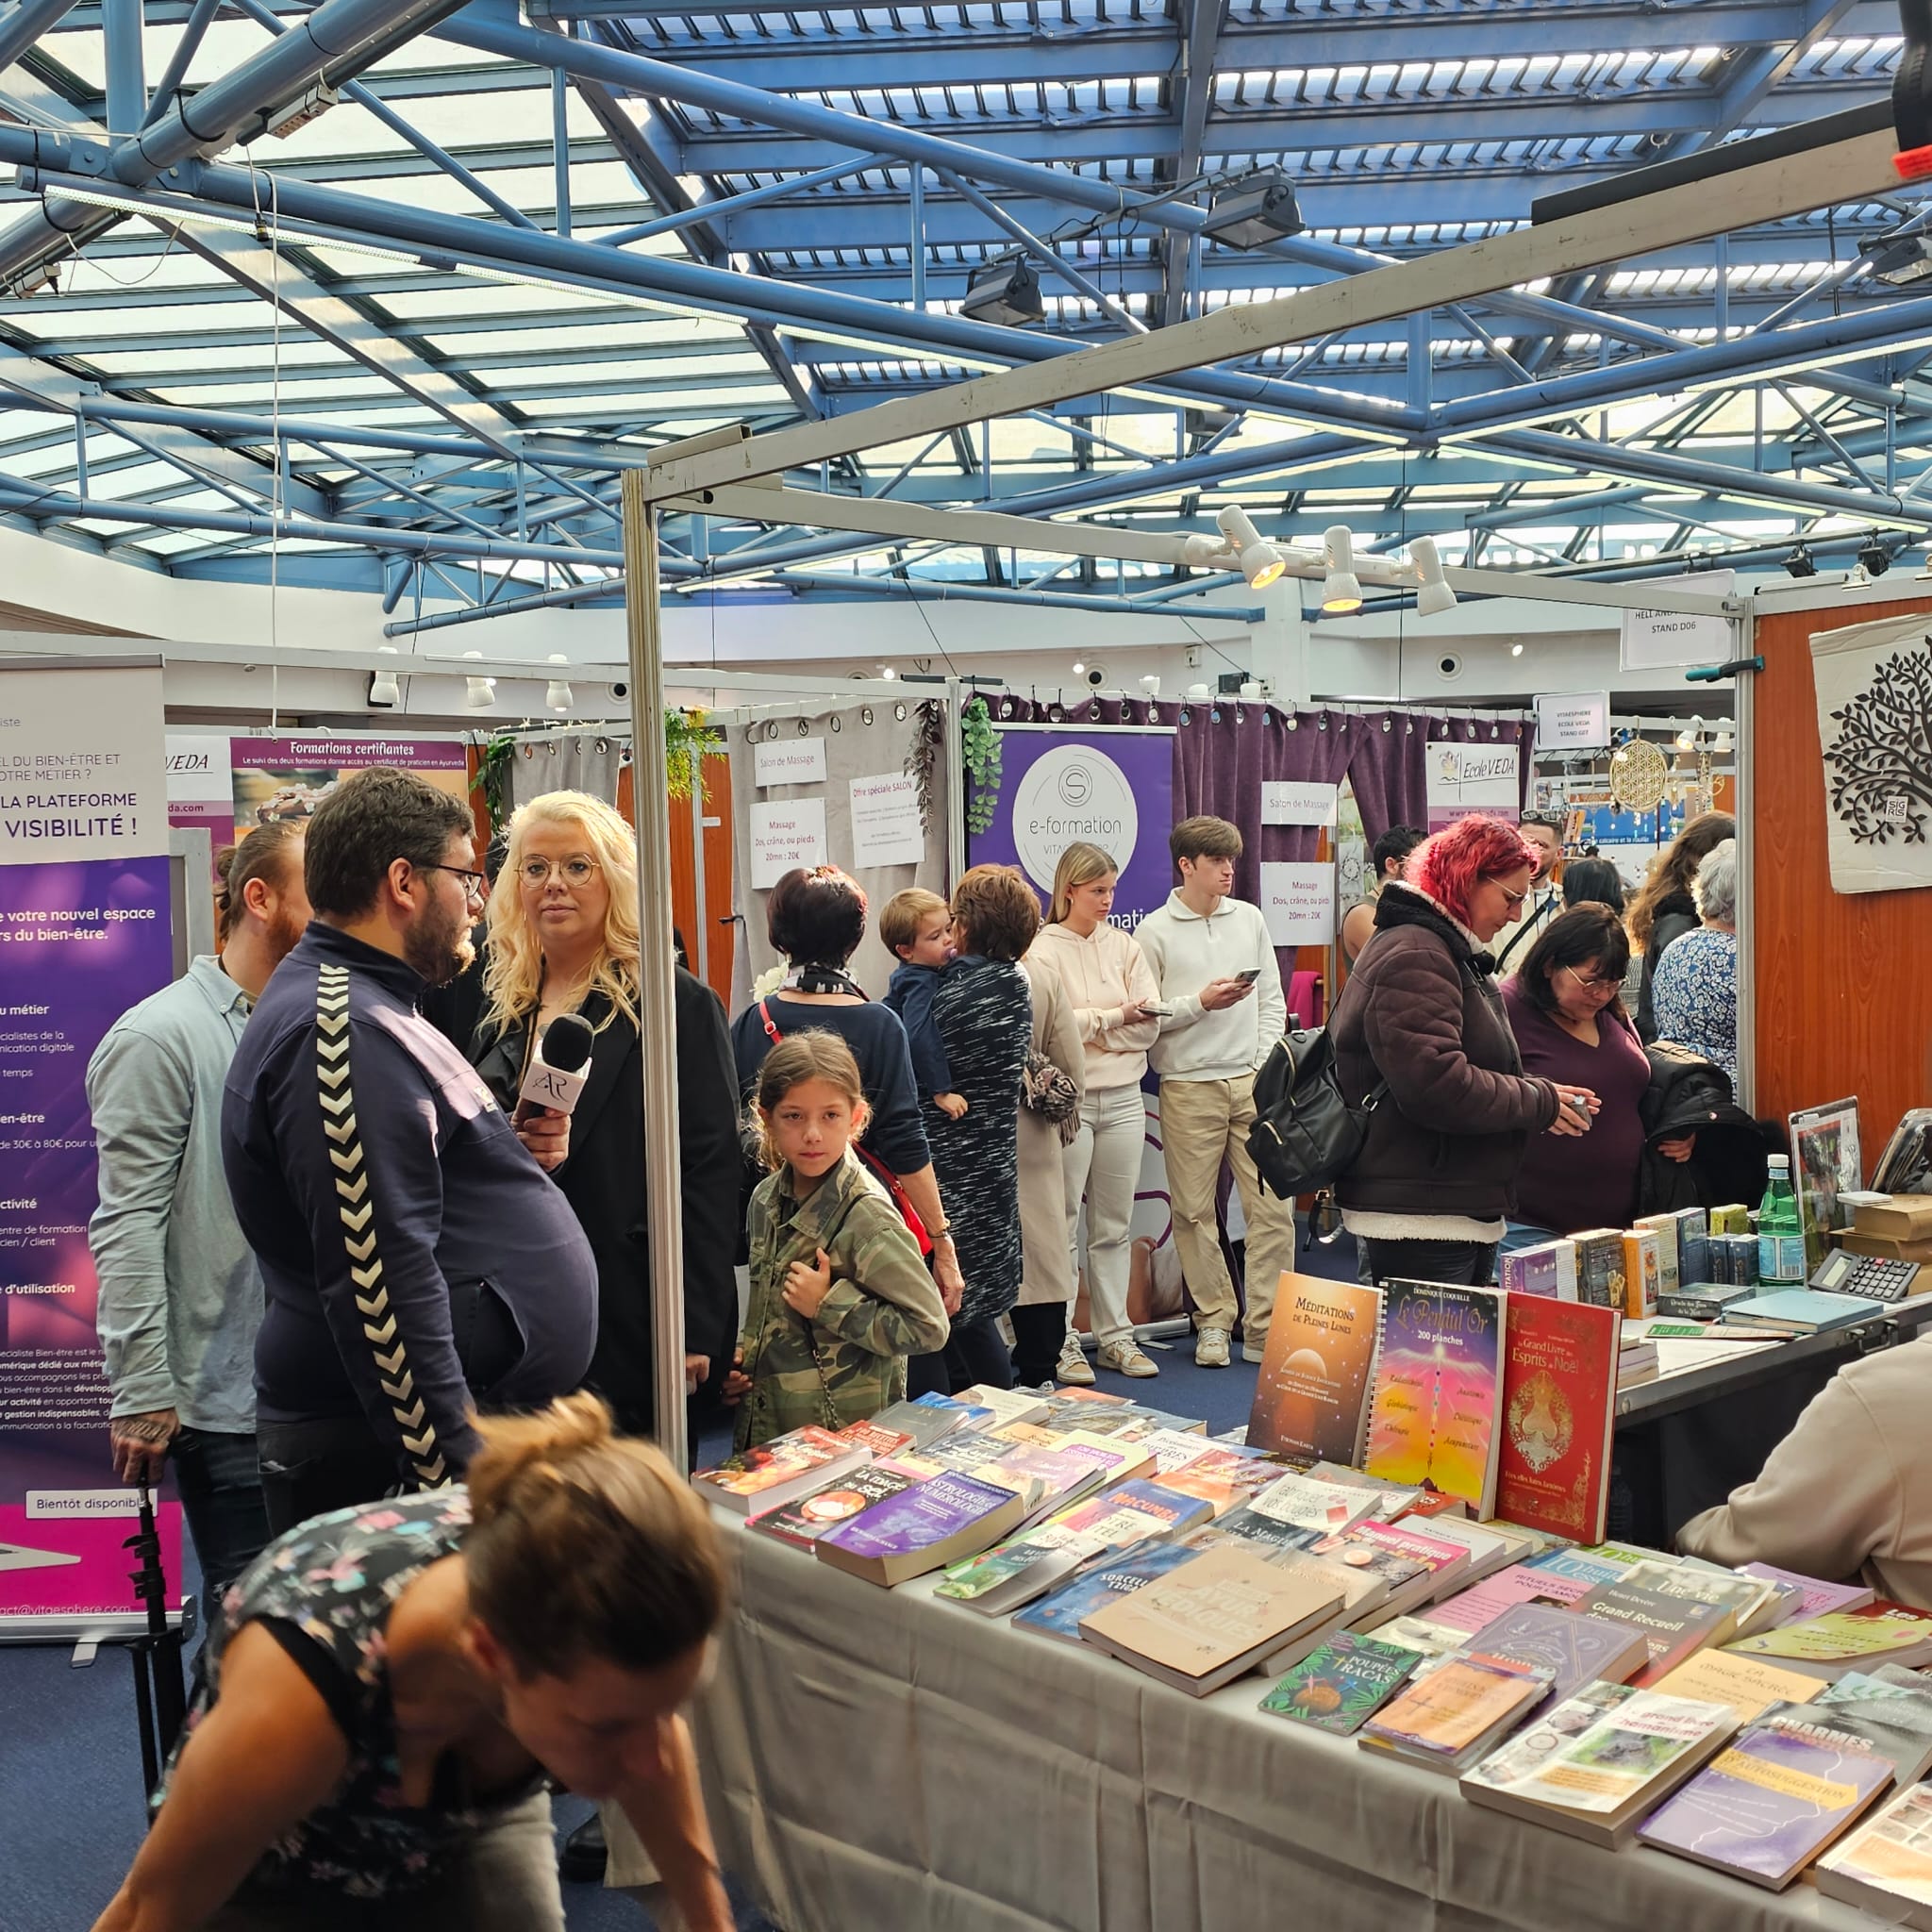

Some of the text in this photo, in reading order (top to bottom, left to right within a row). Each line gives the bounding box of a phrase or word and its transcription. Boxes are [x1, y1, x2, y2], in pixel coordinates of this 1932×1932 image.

[1652, 623, 1678, 633] STAND
[290, 741, 414, 756] Formations certifiantes
[13, 756, 31, 767] DU
[105, 754, 121, 765] ET
[760, 755, 815, 769] Salon de Massage
[891, 780, 912, 791] SALON
[1, 793, 138, 808] LA PLATEFORME
[1269, 798, 1330, 811] Salon de Massage
[5, 813, 137, 838] VISIBILITÉ !
[769, 821, 796, 830] Massage
[1029, 816, 1122, 835] e-formation
[786, 836, 795, 845] ou
[796, 834, 815, 847] pieds
[765, 852, 783, 861] 20mn
[1291, 881, 1318, 891] Massage
[8, 908, 156, 923] votre nouvel espace
[15, 929, 34, 941] du
[38, 928, 108, 941] bien-être.
[9, 1004, 50, 1015] métier
[40, 1031, 53, 1041] de
[55, 1030, 64, 1040] la
[39, 1042, 75, 1054] digitale
[3, 1069, 34, 1079] temps
[13, 1140, 32, 1149] 30€
[43, 1140, 62, 1148] 80€
[65, 1140, 87, 1149] pour
[24, 1225, 37, 1234] de
[39, 1224, 87, 1234] formation
[29, 1237, 56, 1246] client
[1295, 1296, 1356, 1322] MÉDITATIONS
[1418, 1329, 1464, 1346] 200 planches
[1523, 1338, 1547, 1352] Grand
[1547, 1342, 1566, 1356] Livre
[1512, 1347, 1547, 1367] Esprits
[38, 1360, 61, 1369] dédié
[14, 1374, 77, 1383] accompagnons
[42, 1385, 62, 1393] dans
[9, 1398, 42, 1407] activité
[4, 1409, 36, 1420] gestion
[37, 1497, 141, 1510] Bientôt disponibl
[1233, 1521, 1251, 1535] LA
[1354, 1525, 1404, 1546] Manuel
[1396, 1540, 1453, 1561] pratique
[1695, 1589, 1720, 1601] vie
[1591, 1602, 1686, 1632] Grand Recueil
[1349, 1655, 1401, 1675] POUPÉES
[1770, 1715, 1875, 1753] CHARMES
